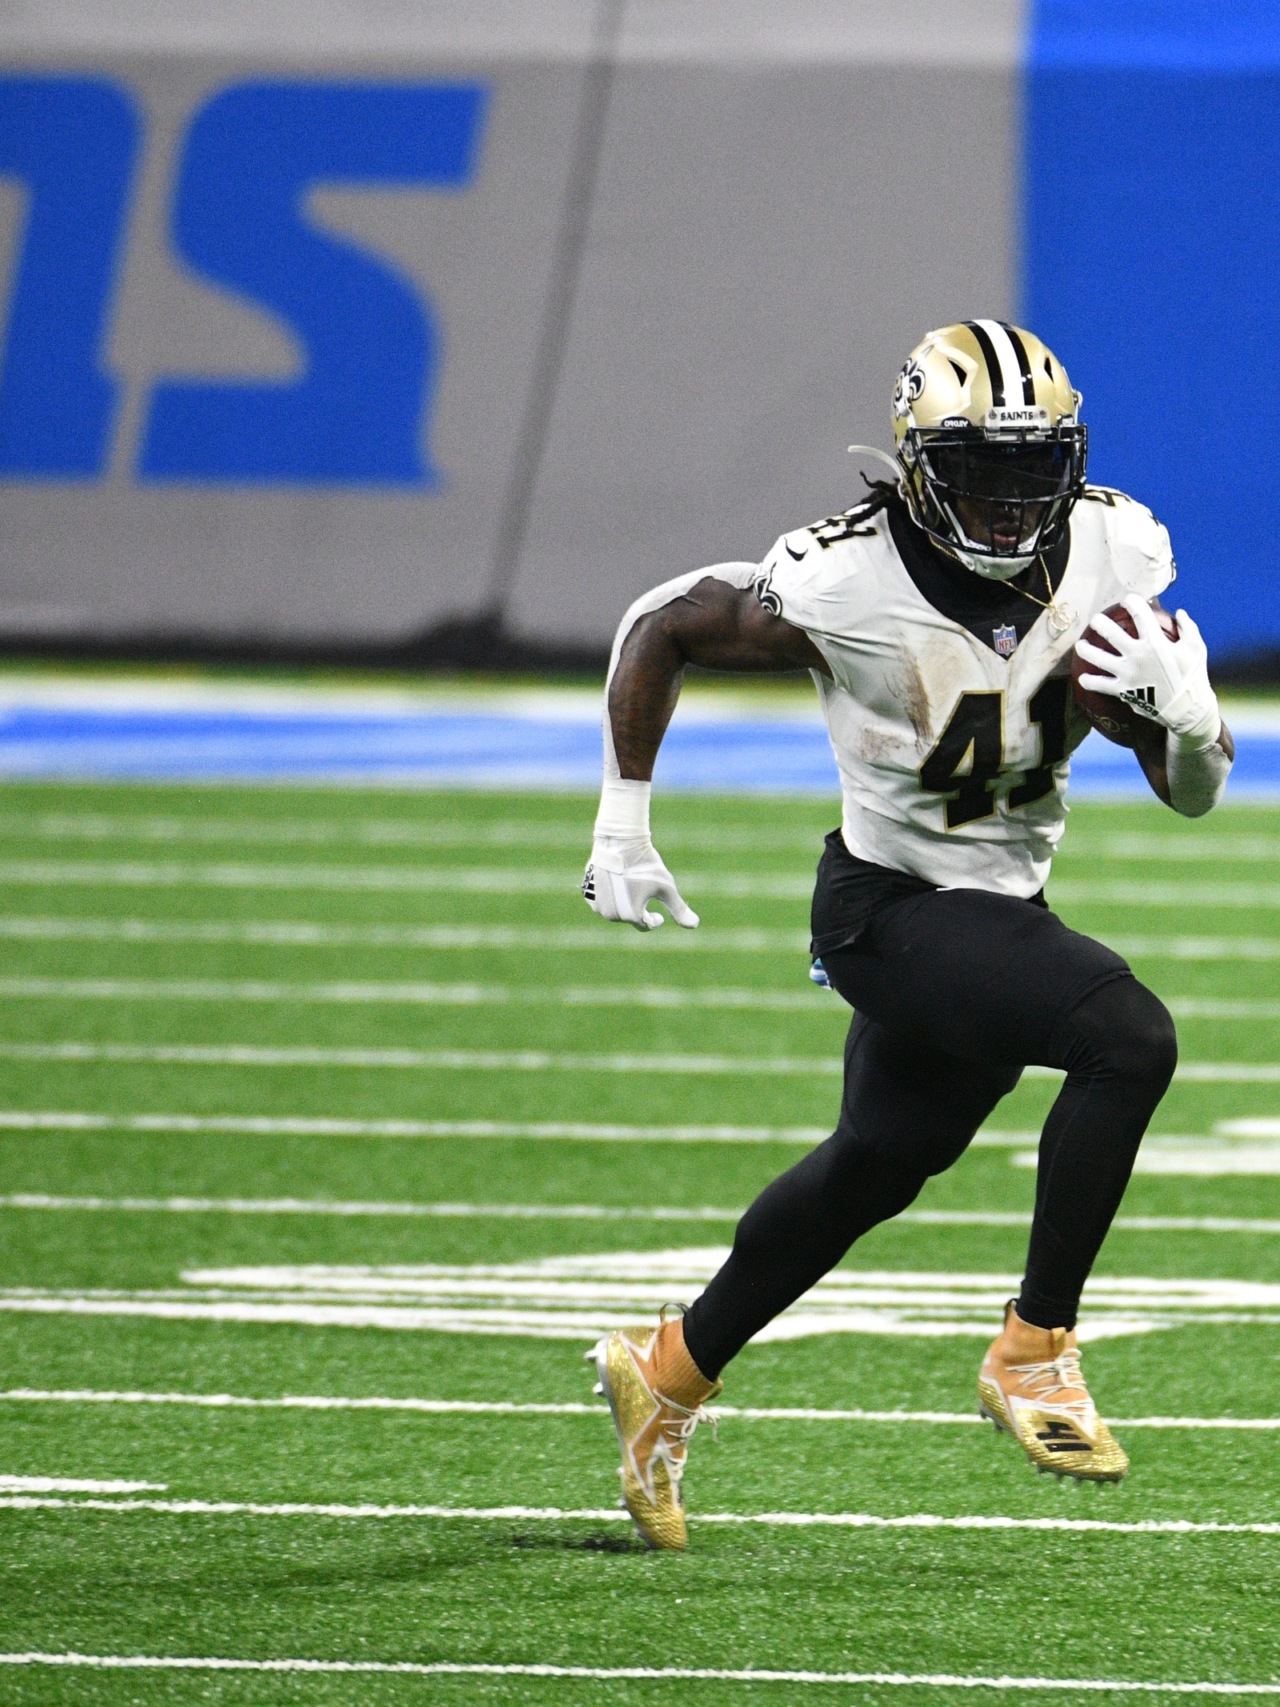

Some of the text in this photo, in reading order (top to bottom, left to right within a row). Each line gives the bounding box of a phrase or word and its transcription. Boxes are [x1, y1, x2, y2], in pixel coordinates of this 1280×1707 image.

[1000, 411, 1034, 421] SAINTS
[998, 638, 1016, 651] NFL
[1119, 691, 1160, 717] adidas
[917, 675, 1070, 833] 41
